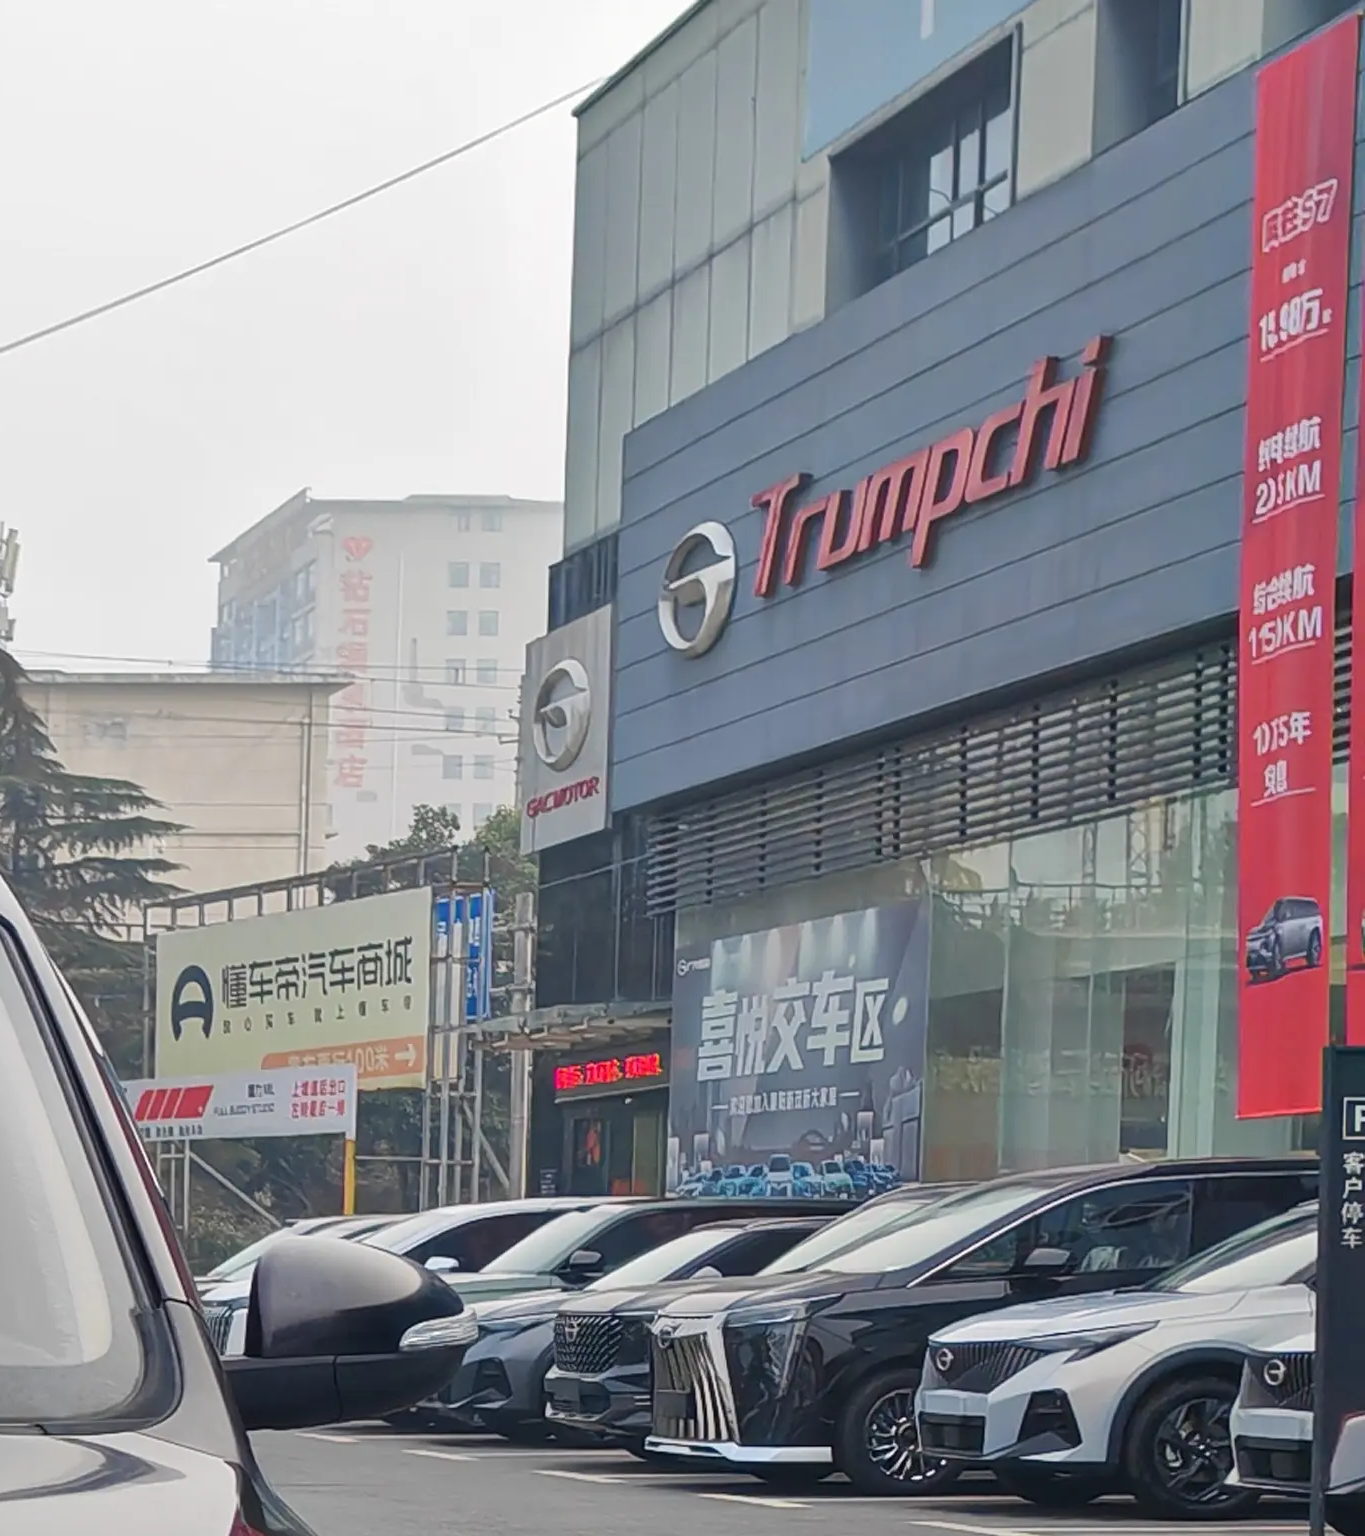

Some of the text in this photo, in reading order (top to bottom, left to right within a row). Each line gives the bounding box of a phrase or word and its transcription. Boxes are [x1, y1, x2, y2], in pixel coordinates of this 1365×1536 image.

[750, 335, 1113, 599] Trumpchi
[221, 936, 413, 1008] 懂车帝汽车商城
[697, 970, 889, 1082] 喜悦交车区
[1340, 1151, 1365, 1249] 客户停车
